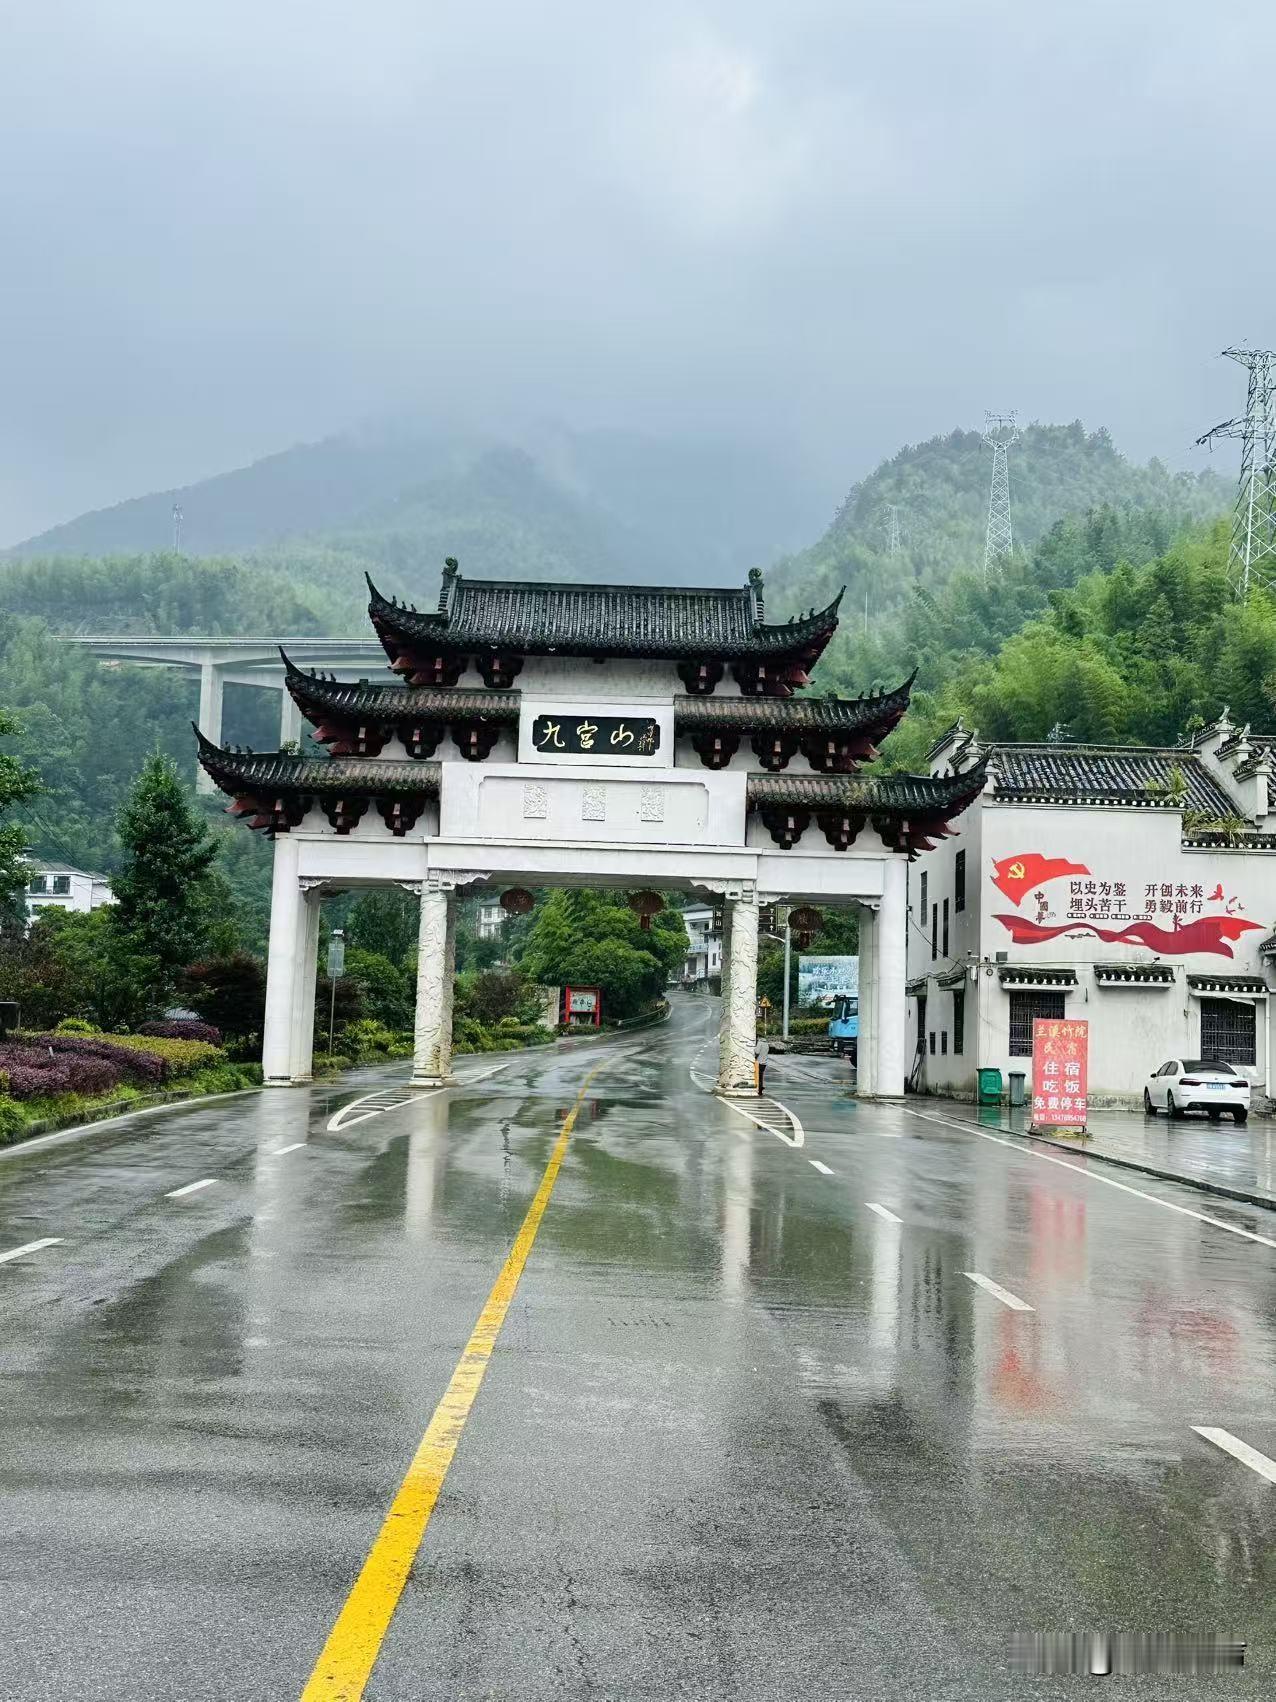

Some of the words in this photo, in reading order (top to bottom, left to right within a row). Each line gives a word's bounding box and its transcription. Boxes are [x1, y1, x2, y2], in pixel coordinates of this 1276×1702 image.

[537, 720, 634, 749] 九宫山
[1070, 881, 1127, 897] 以史为鉴
[1145, 883, 1204, 898] 开创未来
[1070, 897, 1127, 912] 埋头苦干
[1145, 899, 1203, 914] 勇毅前行
[1043, 1061, 1081, 1076] 住宿
[1043, 1080, 1081, 1094] 吃饭
[1033, 1097, 1086, 1111] 免费停车
